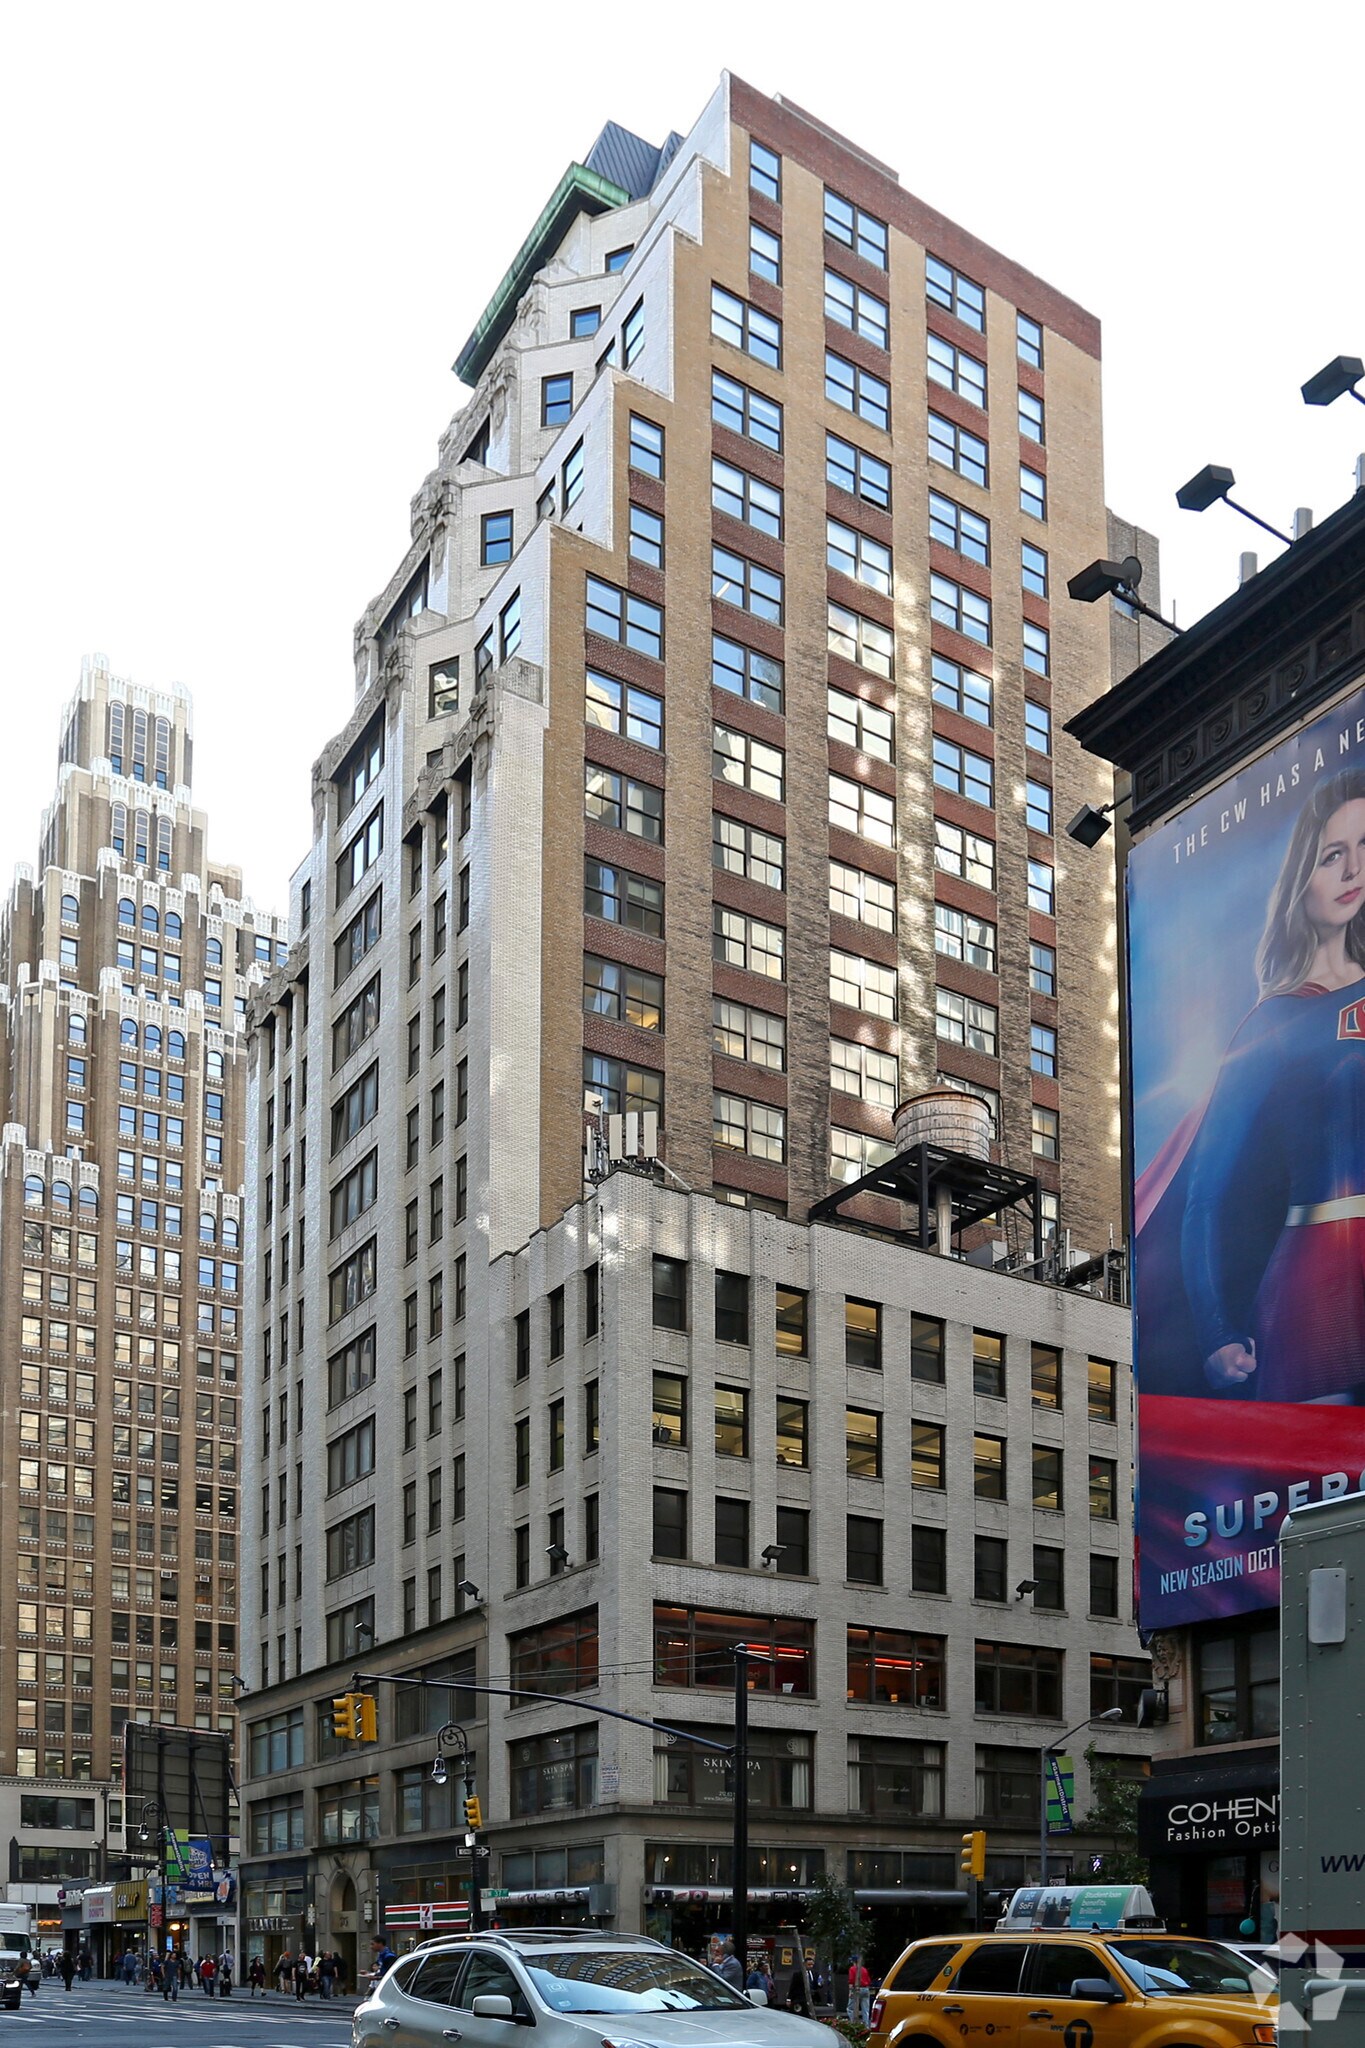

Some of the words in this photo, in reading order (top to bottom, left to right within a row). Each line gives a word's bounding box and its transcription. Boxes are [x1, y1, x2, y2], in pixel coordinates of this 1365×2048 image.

[1172, 827, 1209, 865] THE
[1219, 798, 1248, 835] CW
[1259, 762, 1301, 808] HAS
[1313, 747, 1326, 773] A
[1184, 1470, 1365, 1548] SUPER
[1160, 1566, 1189, 1596] NEW
[1191, 1553, 1244, 1588] SEASON
[1247, 1545, 1276, 1575] OCT
[542, 1765, 558, 1776] SKIN
[560, 1763, 573, 1773] SPA
[703, 1758, 732, 1769] SKIN
[747, 1760, 761, 1771] PA
[1167, 1825, 1226, 1841] Fashion
[1109, 1891, 1123, 1899] loan
[1018, 1902, 1034, 1910] SoFi
